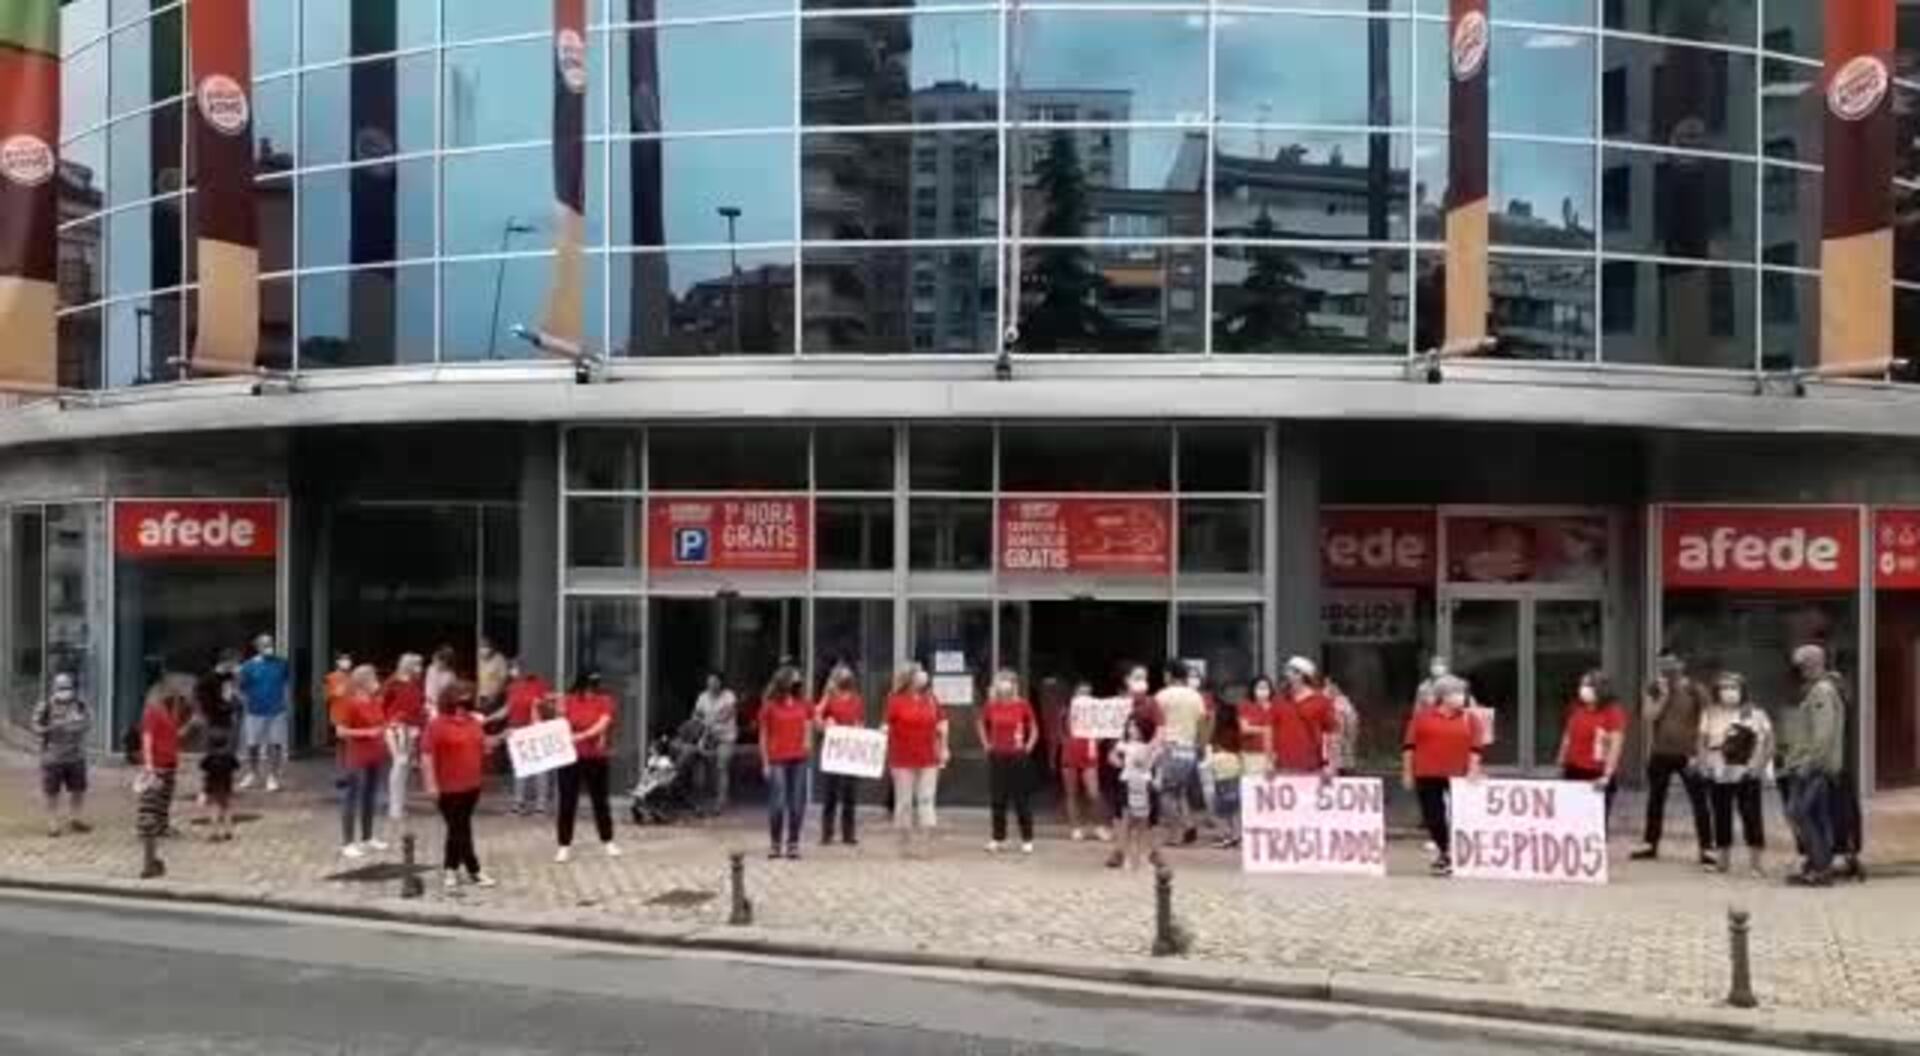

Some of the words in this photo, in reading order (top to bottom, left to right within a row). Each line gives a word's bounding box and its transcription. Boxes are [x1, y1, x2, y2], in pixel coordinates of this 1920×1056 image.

[743, 502, 795, 524] HORA
[138, 510, 255, 546] afede
[722, 525, 797, 547] GRATIS
[681, 530, 702, 558] P
[1004, 548, 1070, 569] GRATIS
[1678, 527, 1839, 571] afede
[1254, 784, 1297, 812] NO
[1316, 783, 1381, 813] SON
[1487, 785, 1555, 818] SON
